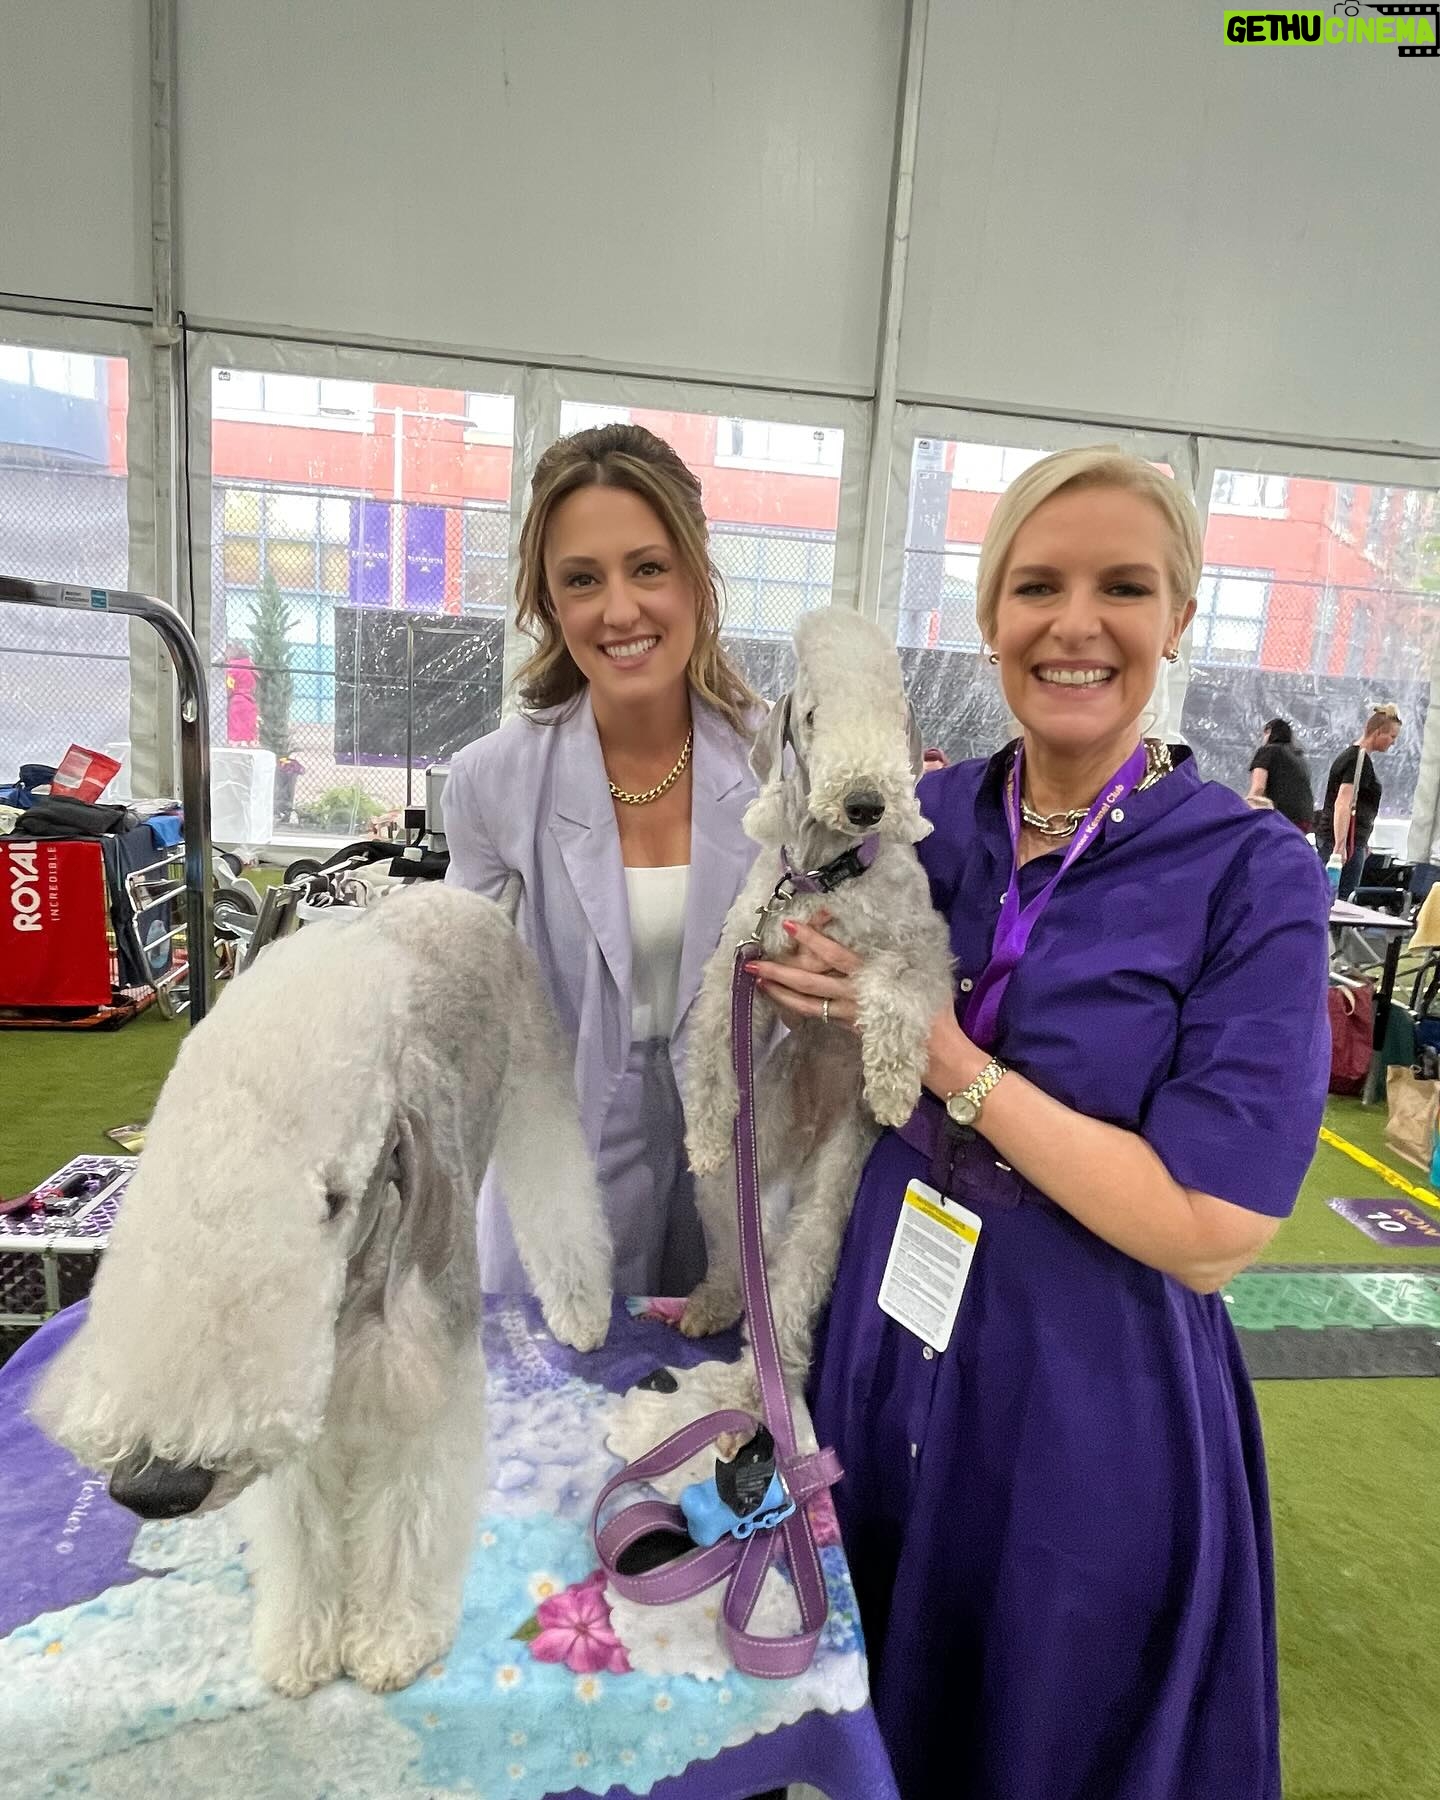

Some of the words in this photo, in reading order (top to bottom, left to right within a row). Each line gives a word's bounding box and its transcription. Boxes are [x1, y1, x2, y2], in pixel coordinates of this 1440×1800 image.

[1085, 802, 1110, 834] Kennel
[1106, 784, 1125, 803] Club
[8, 841, 43, 931] ROYAL
[47, 846, 60, 921] INCREDIBLE
[1366, 1211, 1407, 1232] 10
